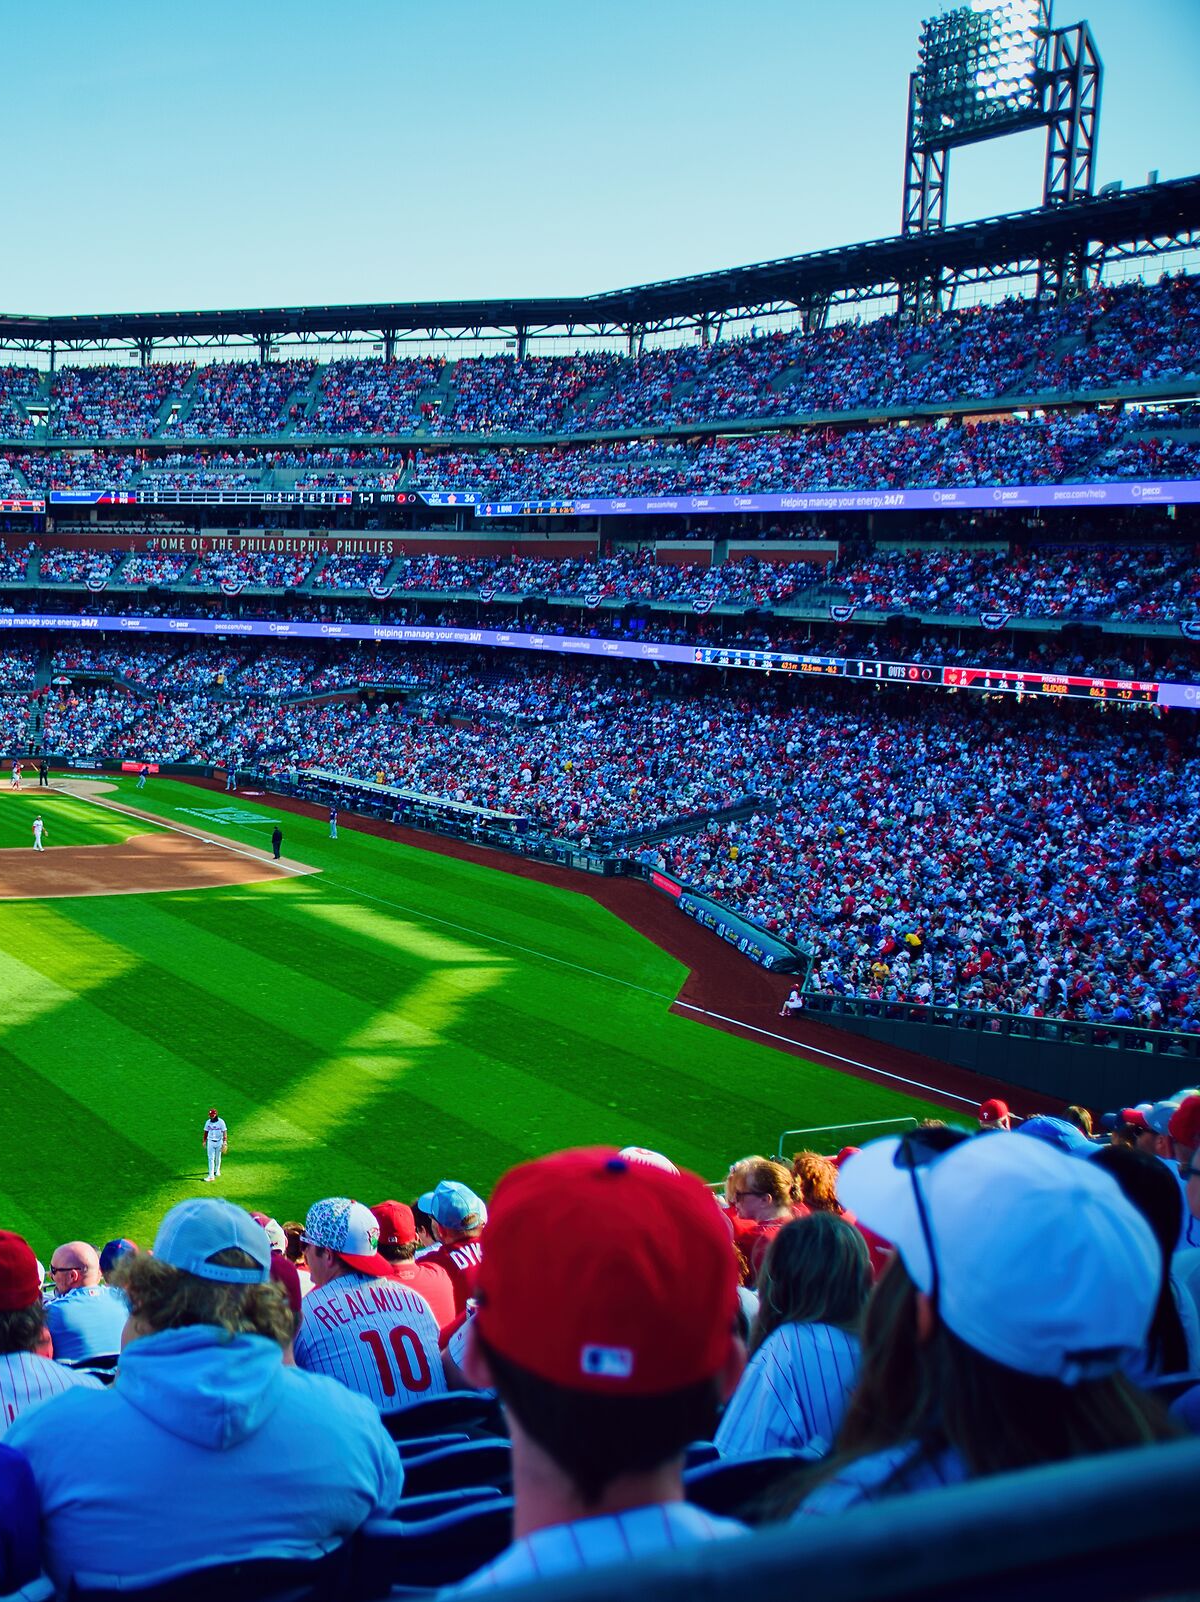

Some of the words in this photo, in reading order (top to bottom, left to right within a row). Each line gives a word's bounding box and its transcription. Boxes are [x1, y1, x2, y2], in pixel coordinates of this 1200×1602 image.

[266, 494, 272, 502] R
[288, 494, 294, 502] H
[310, 494, 315, 502] E
[359, 494, 373, 503] 1-1
[464, 494, 475, 502] 36
[781, 498, 807, 508] Helping
[808, 499, 837, 507] manage
[838, 498, 855, 507] your
[153, 538, 185, 550] HOME
[212, 539, 233, 550] THE
[240, 539, 328, 551] PHILADELPHI
[336, 540, 394, 552] PHILLIES
[14, 618, 40, 626] manage
[41, 618, 57, 627] your
[374, 628, 403, 639] Helping
[404, 631, 434, 640] manage
[436, 632, 453, 641] your
[761, 660, 772, 668] .324
[888, 667, 905, 677] OUTS
[999, 680, 1008, 688] 24
[1015, 681, 1024, 689] 32
[1042, 683, 1068, 693] SLIDER
[1090, 687, 1106, 697] 86.2
[1117, 690, 1132, 699] -1.7
[1142, 692, 1152, 700] -1
[313, 1286, 424, 1332] REALMUTO
[360, 1325, 432, 1397] 10
